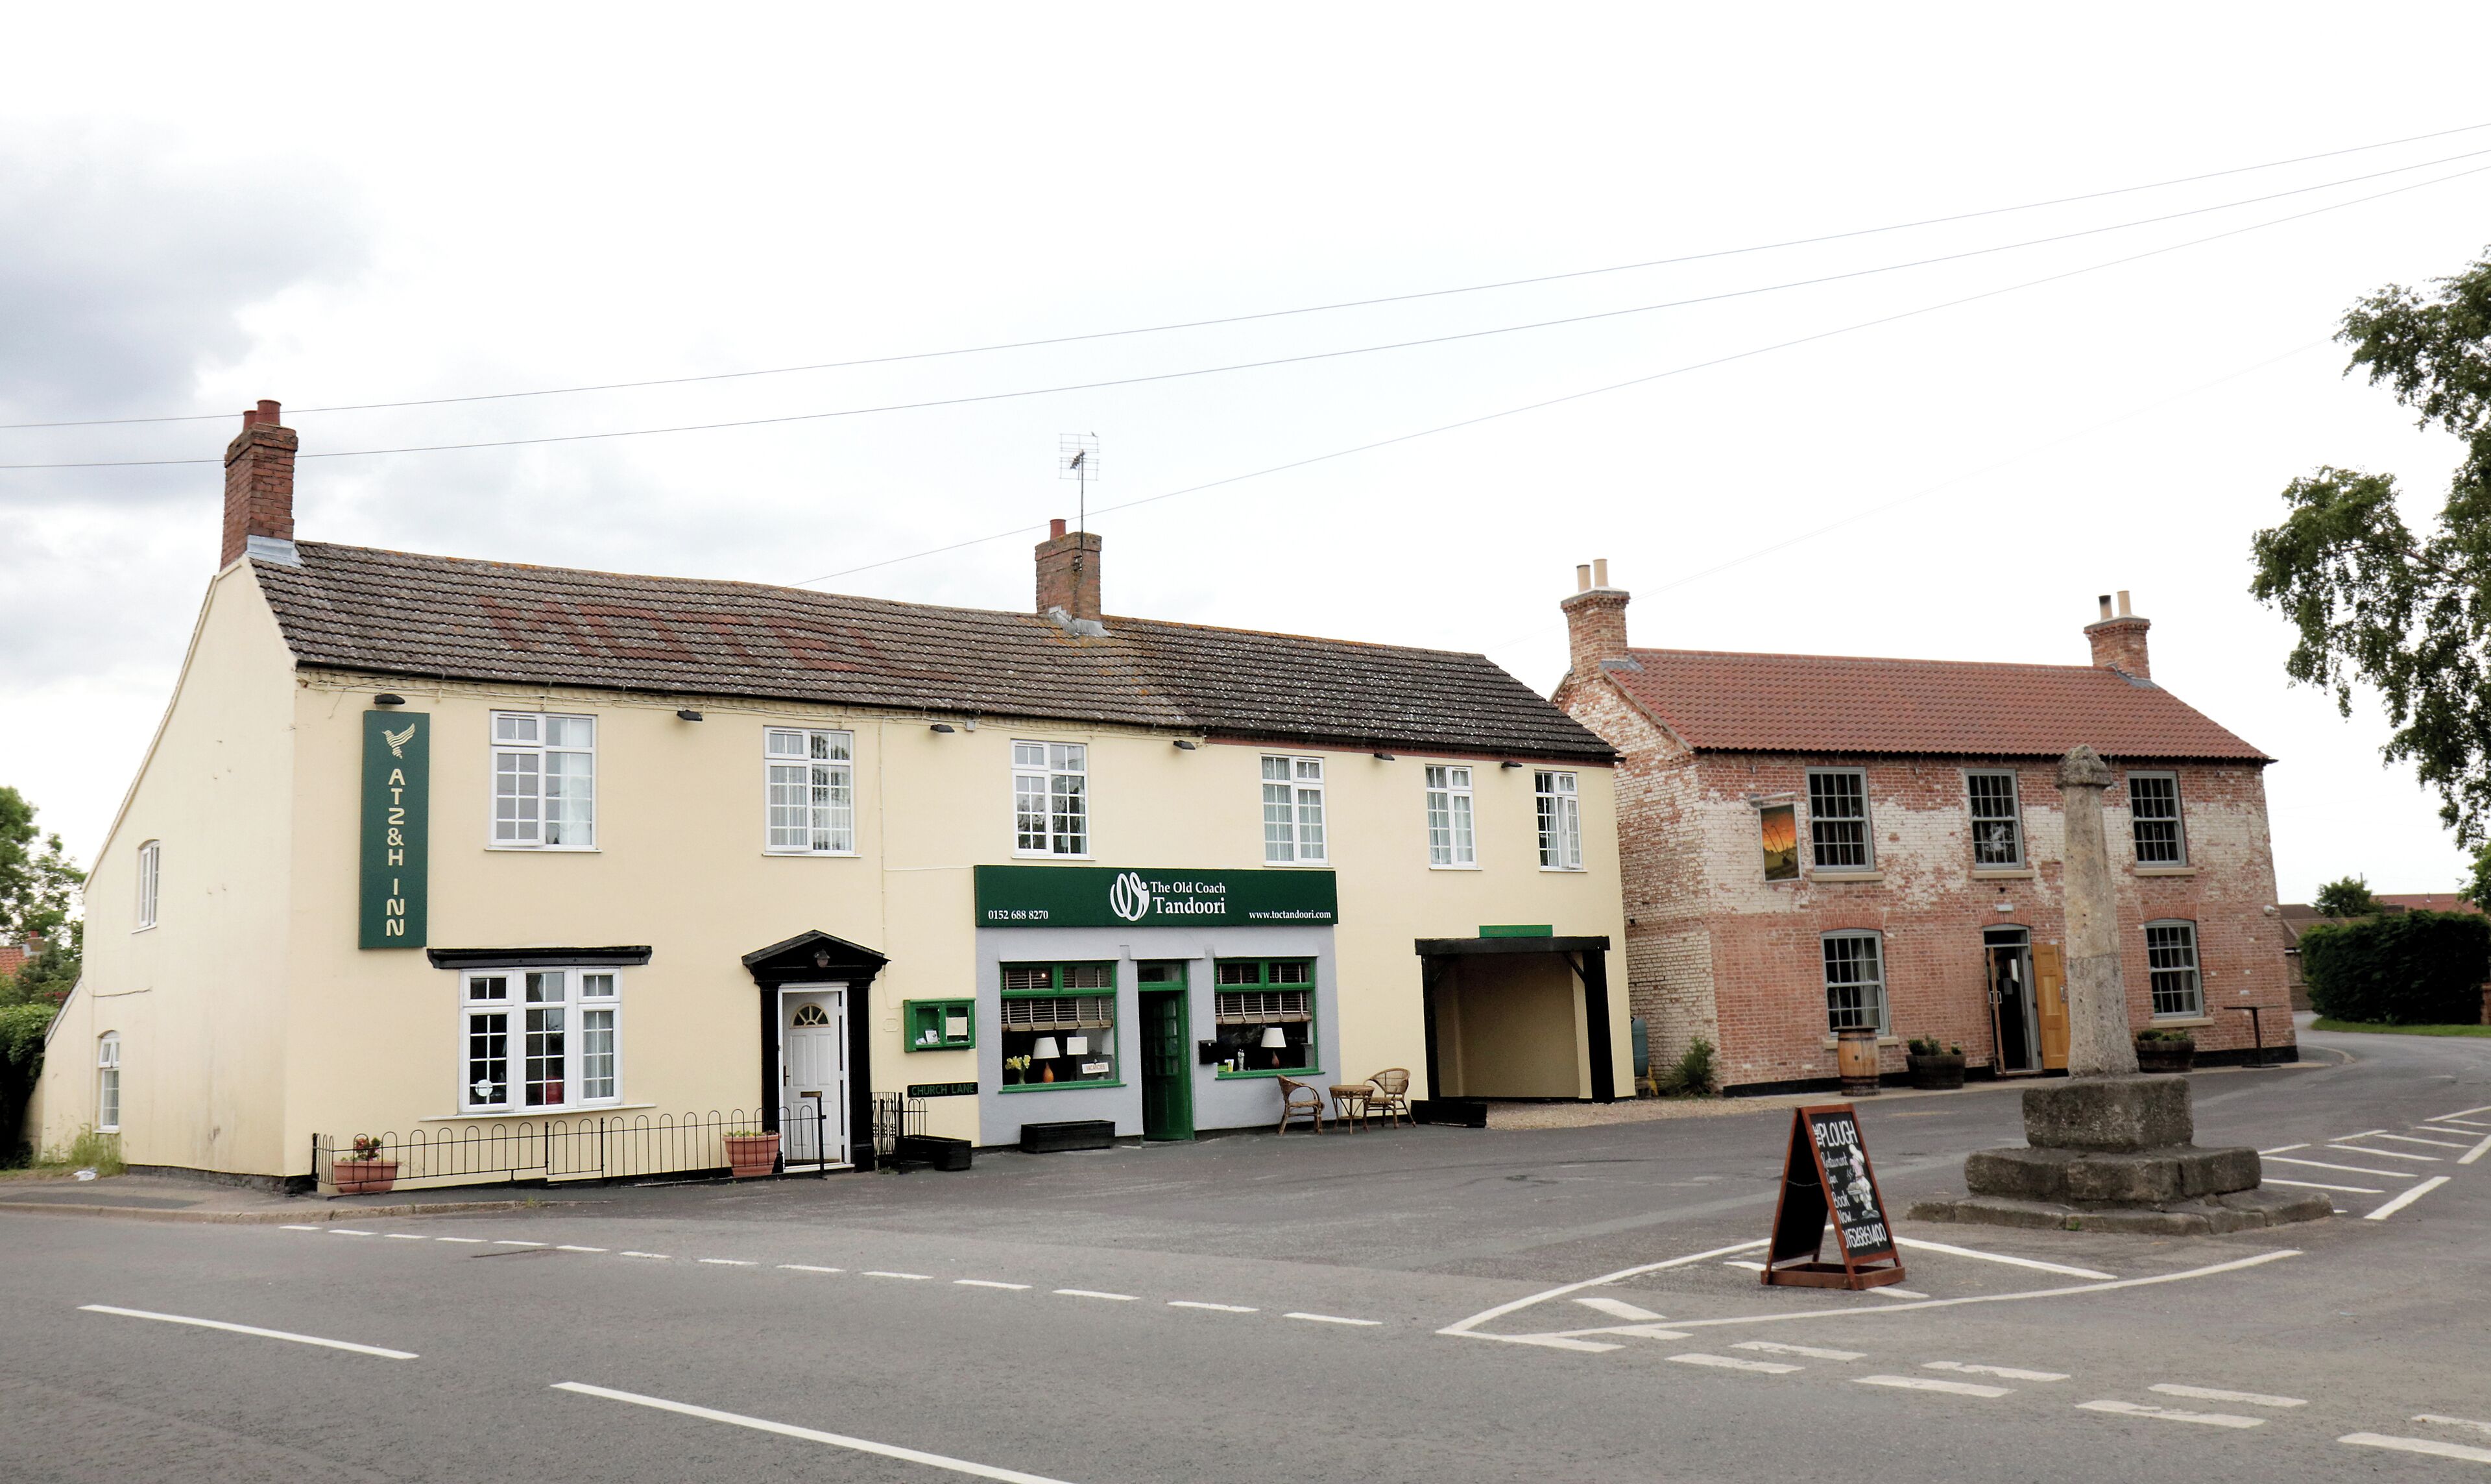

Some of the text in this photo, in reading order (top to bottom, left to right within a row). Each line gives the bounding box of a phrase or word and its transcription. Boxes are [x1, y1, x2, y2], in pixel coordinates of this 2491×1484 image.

[1150, 881, 1226, 894] The Old Coach
[386, 878, 405, 936] INN
[1153, 896, 1226, 914] Tandoori
[988, 910, 1049, 920] 0152 688 8270
[1249, 909, 1332, 919] www.toctandoori.com
[911, 1083, 975, 1096] CHURCH LANE
[1812, 1120, 1859, 1147] THE PLOUGH
[1831, 1190, 1850, 1208] Book
